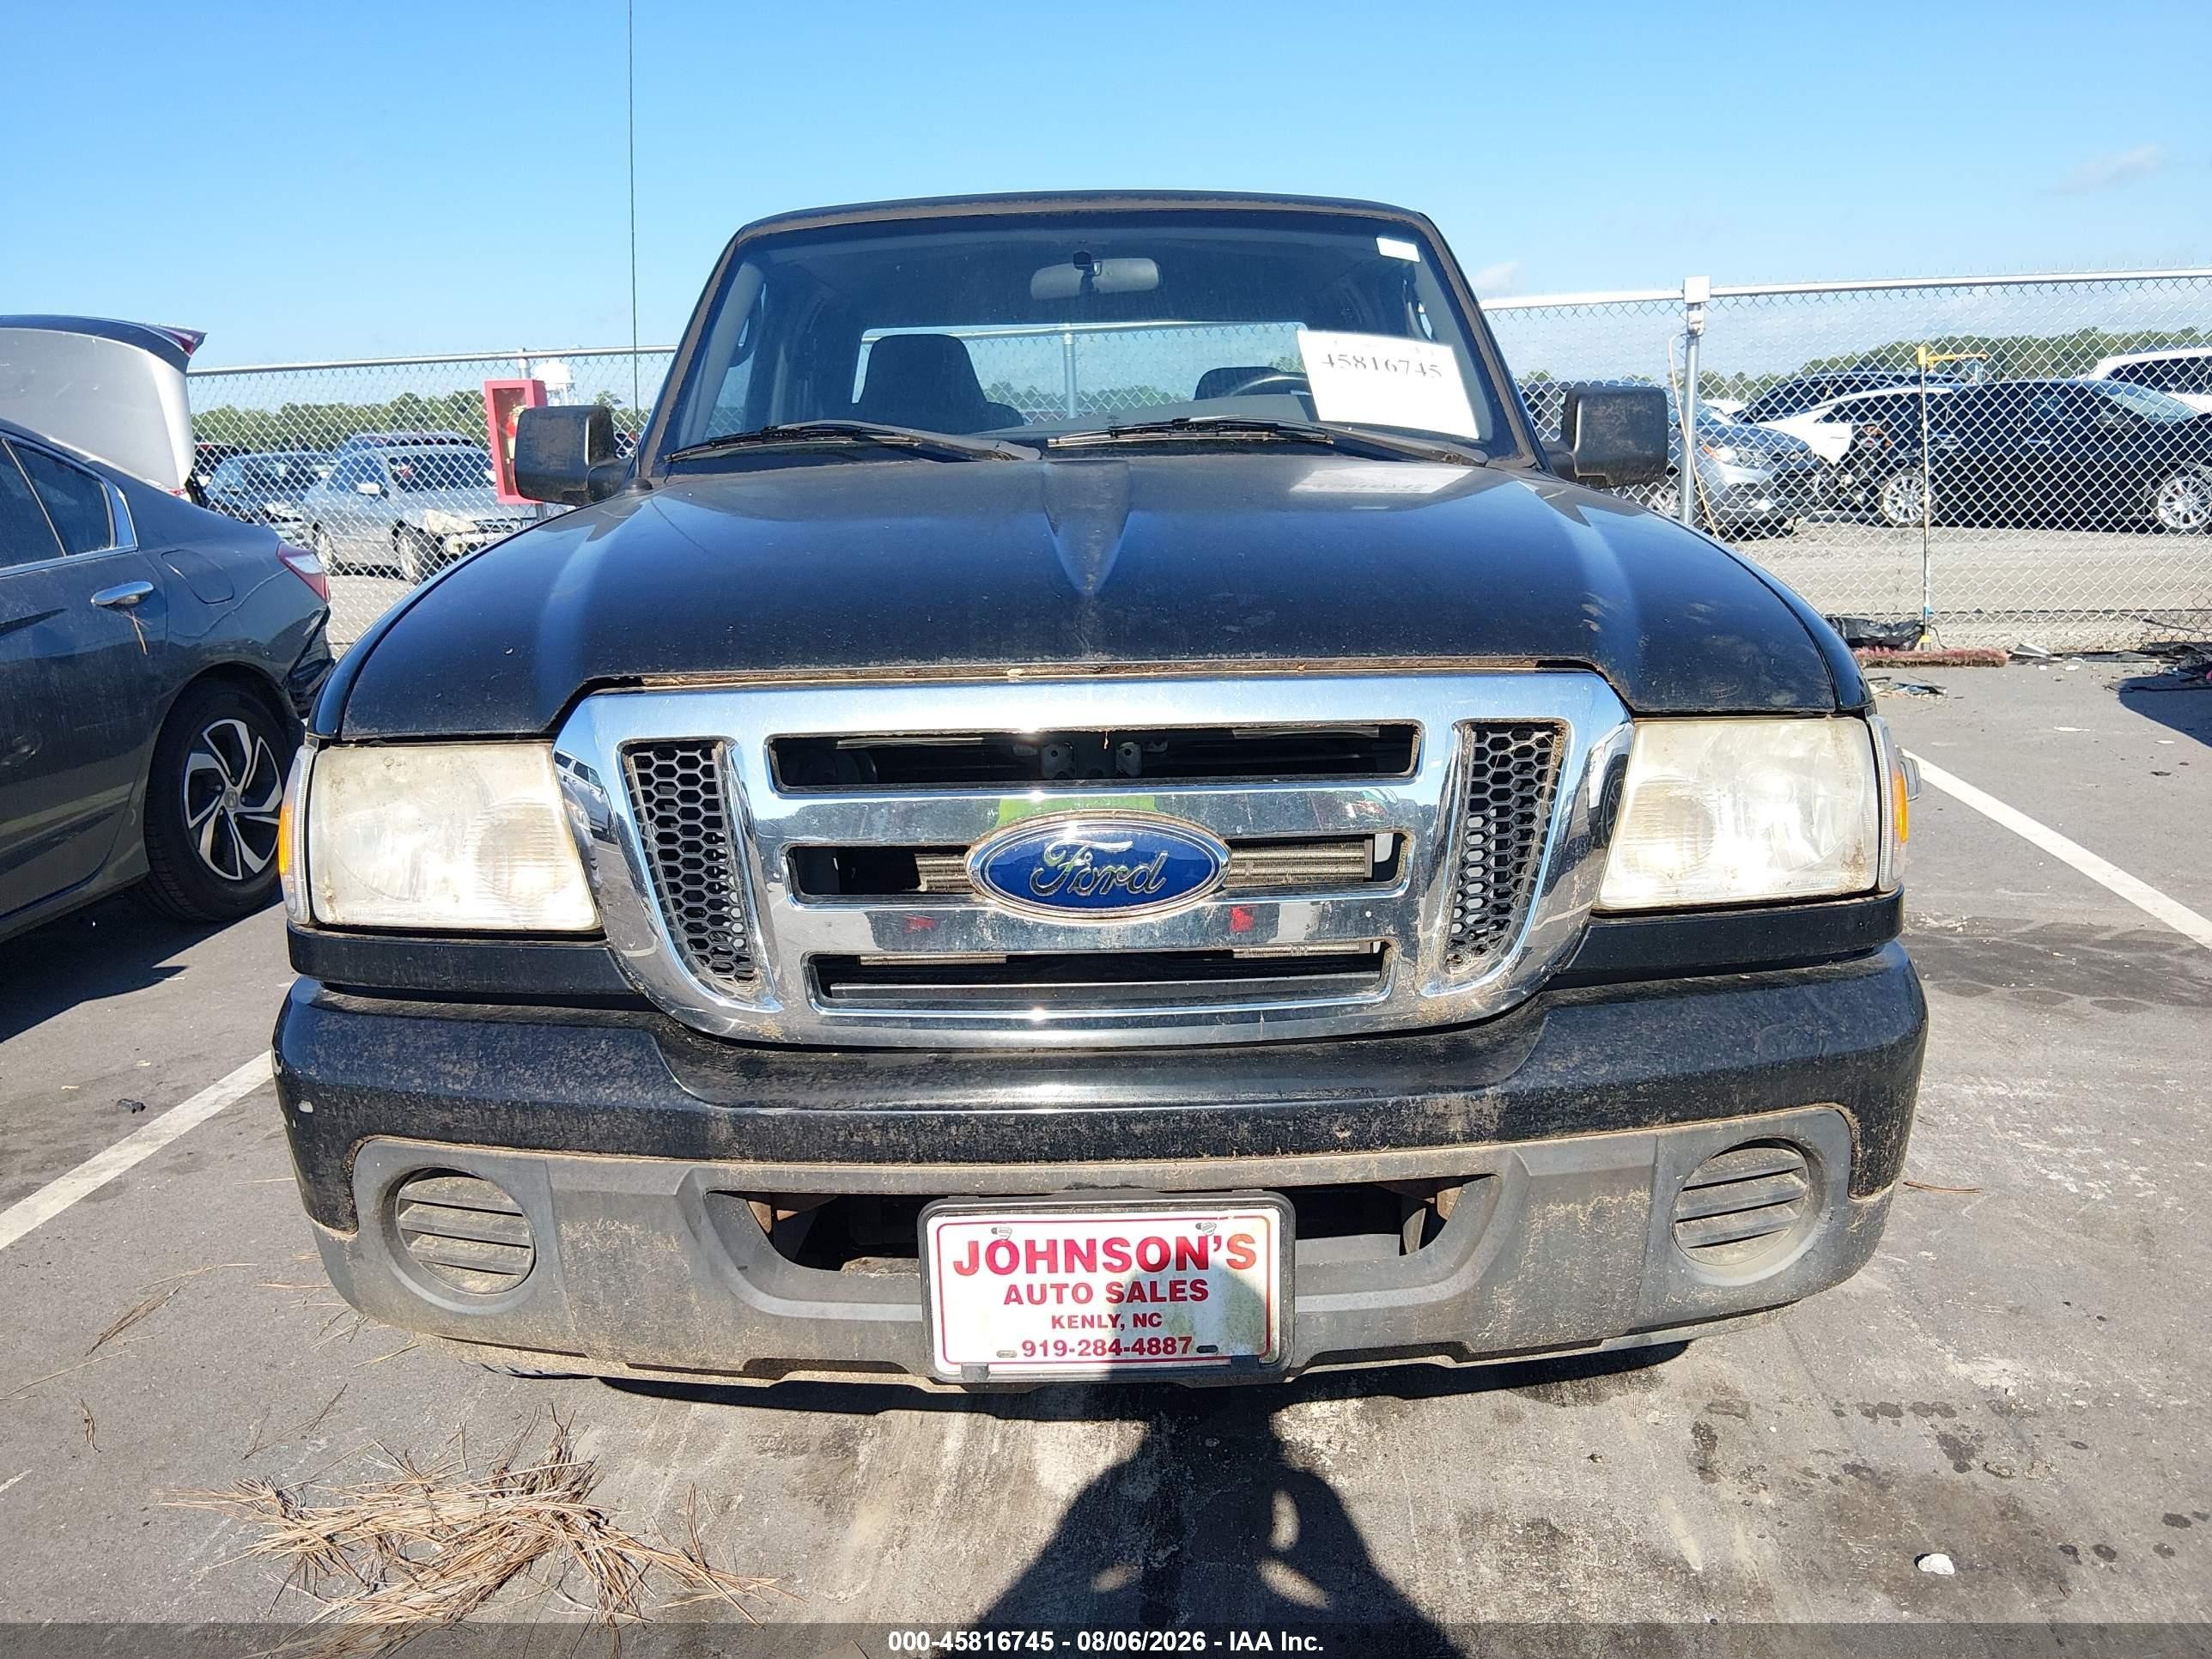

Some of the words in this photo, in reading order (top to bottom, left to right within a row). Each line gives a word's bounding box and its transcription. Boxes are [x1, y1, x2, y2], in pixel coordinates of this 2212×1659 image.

[1322, 353, 1442, 378] 45816745
[1030, 837, 1169, 896] Ford
[952, 1233, 1256, 1277] JOHNSON'S
[1003, 1282, 1094, 1305] AUTO
[1105, 1279, 1210, 1304] SALES
[1051, 1314, 1125, 1332] KENLY,
[1132, 1313, 1163, 1328] NC
[1021, 1336, 1193, 1358] 919-284-4887
